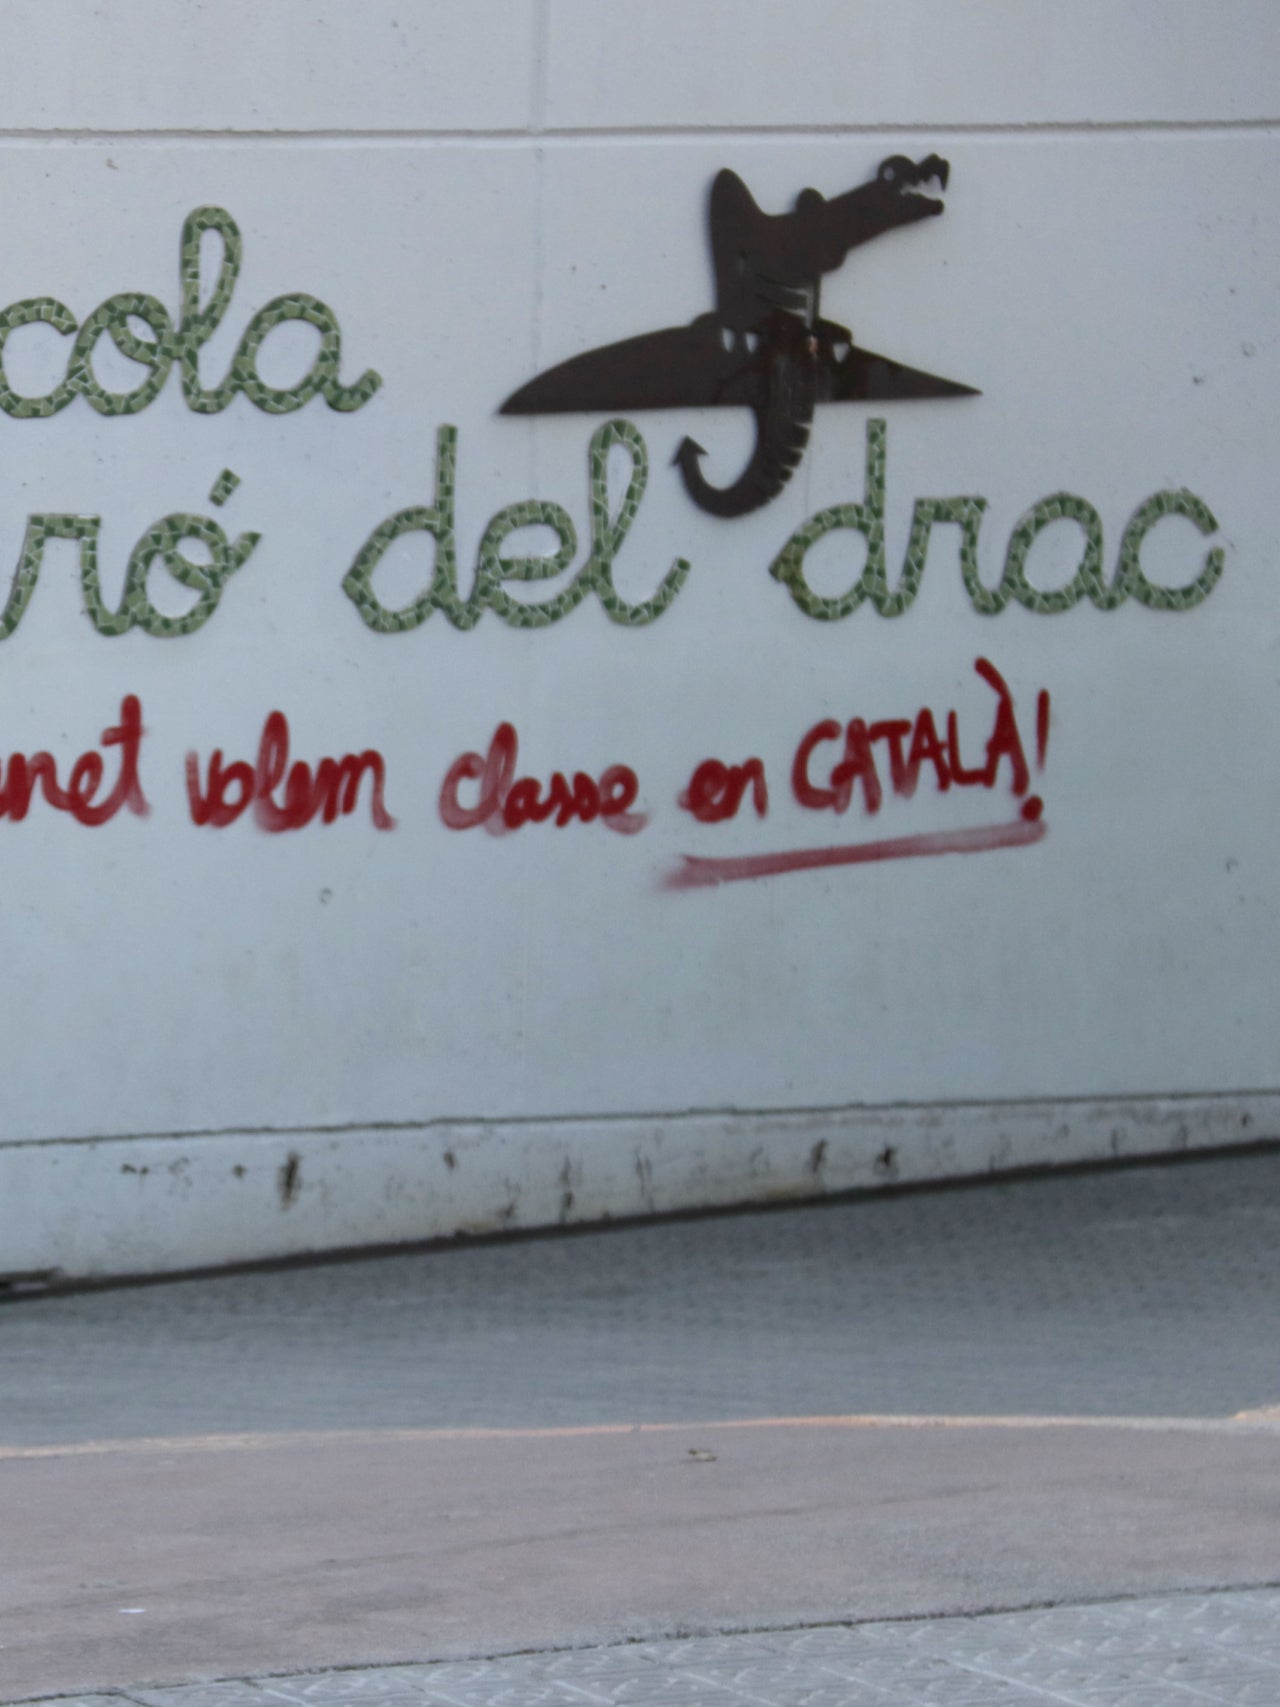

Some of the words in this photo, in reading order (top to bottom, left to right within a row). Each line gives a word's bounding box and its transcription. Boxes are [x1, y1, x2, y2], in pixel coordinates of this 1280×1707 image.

[340, 419, 691, 633] del
[769, 418, 1226, 620] drac
[186, 710, 397, 833] volem
[438, 721, 649, 837] classe
[677, 756, 767, 823] en
